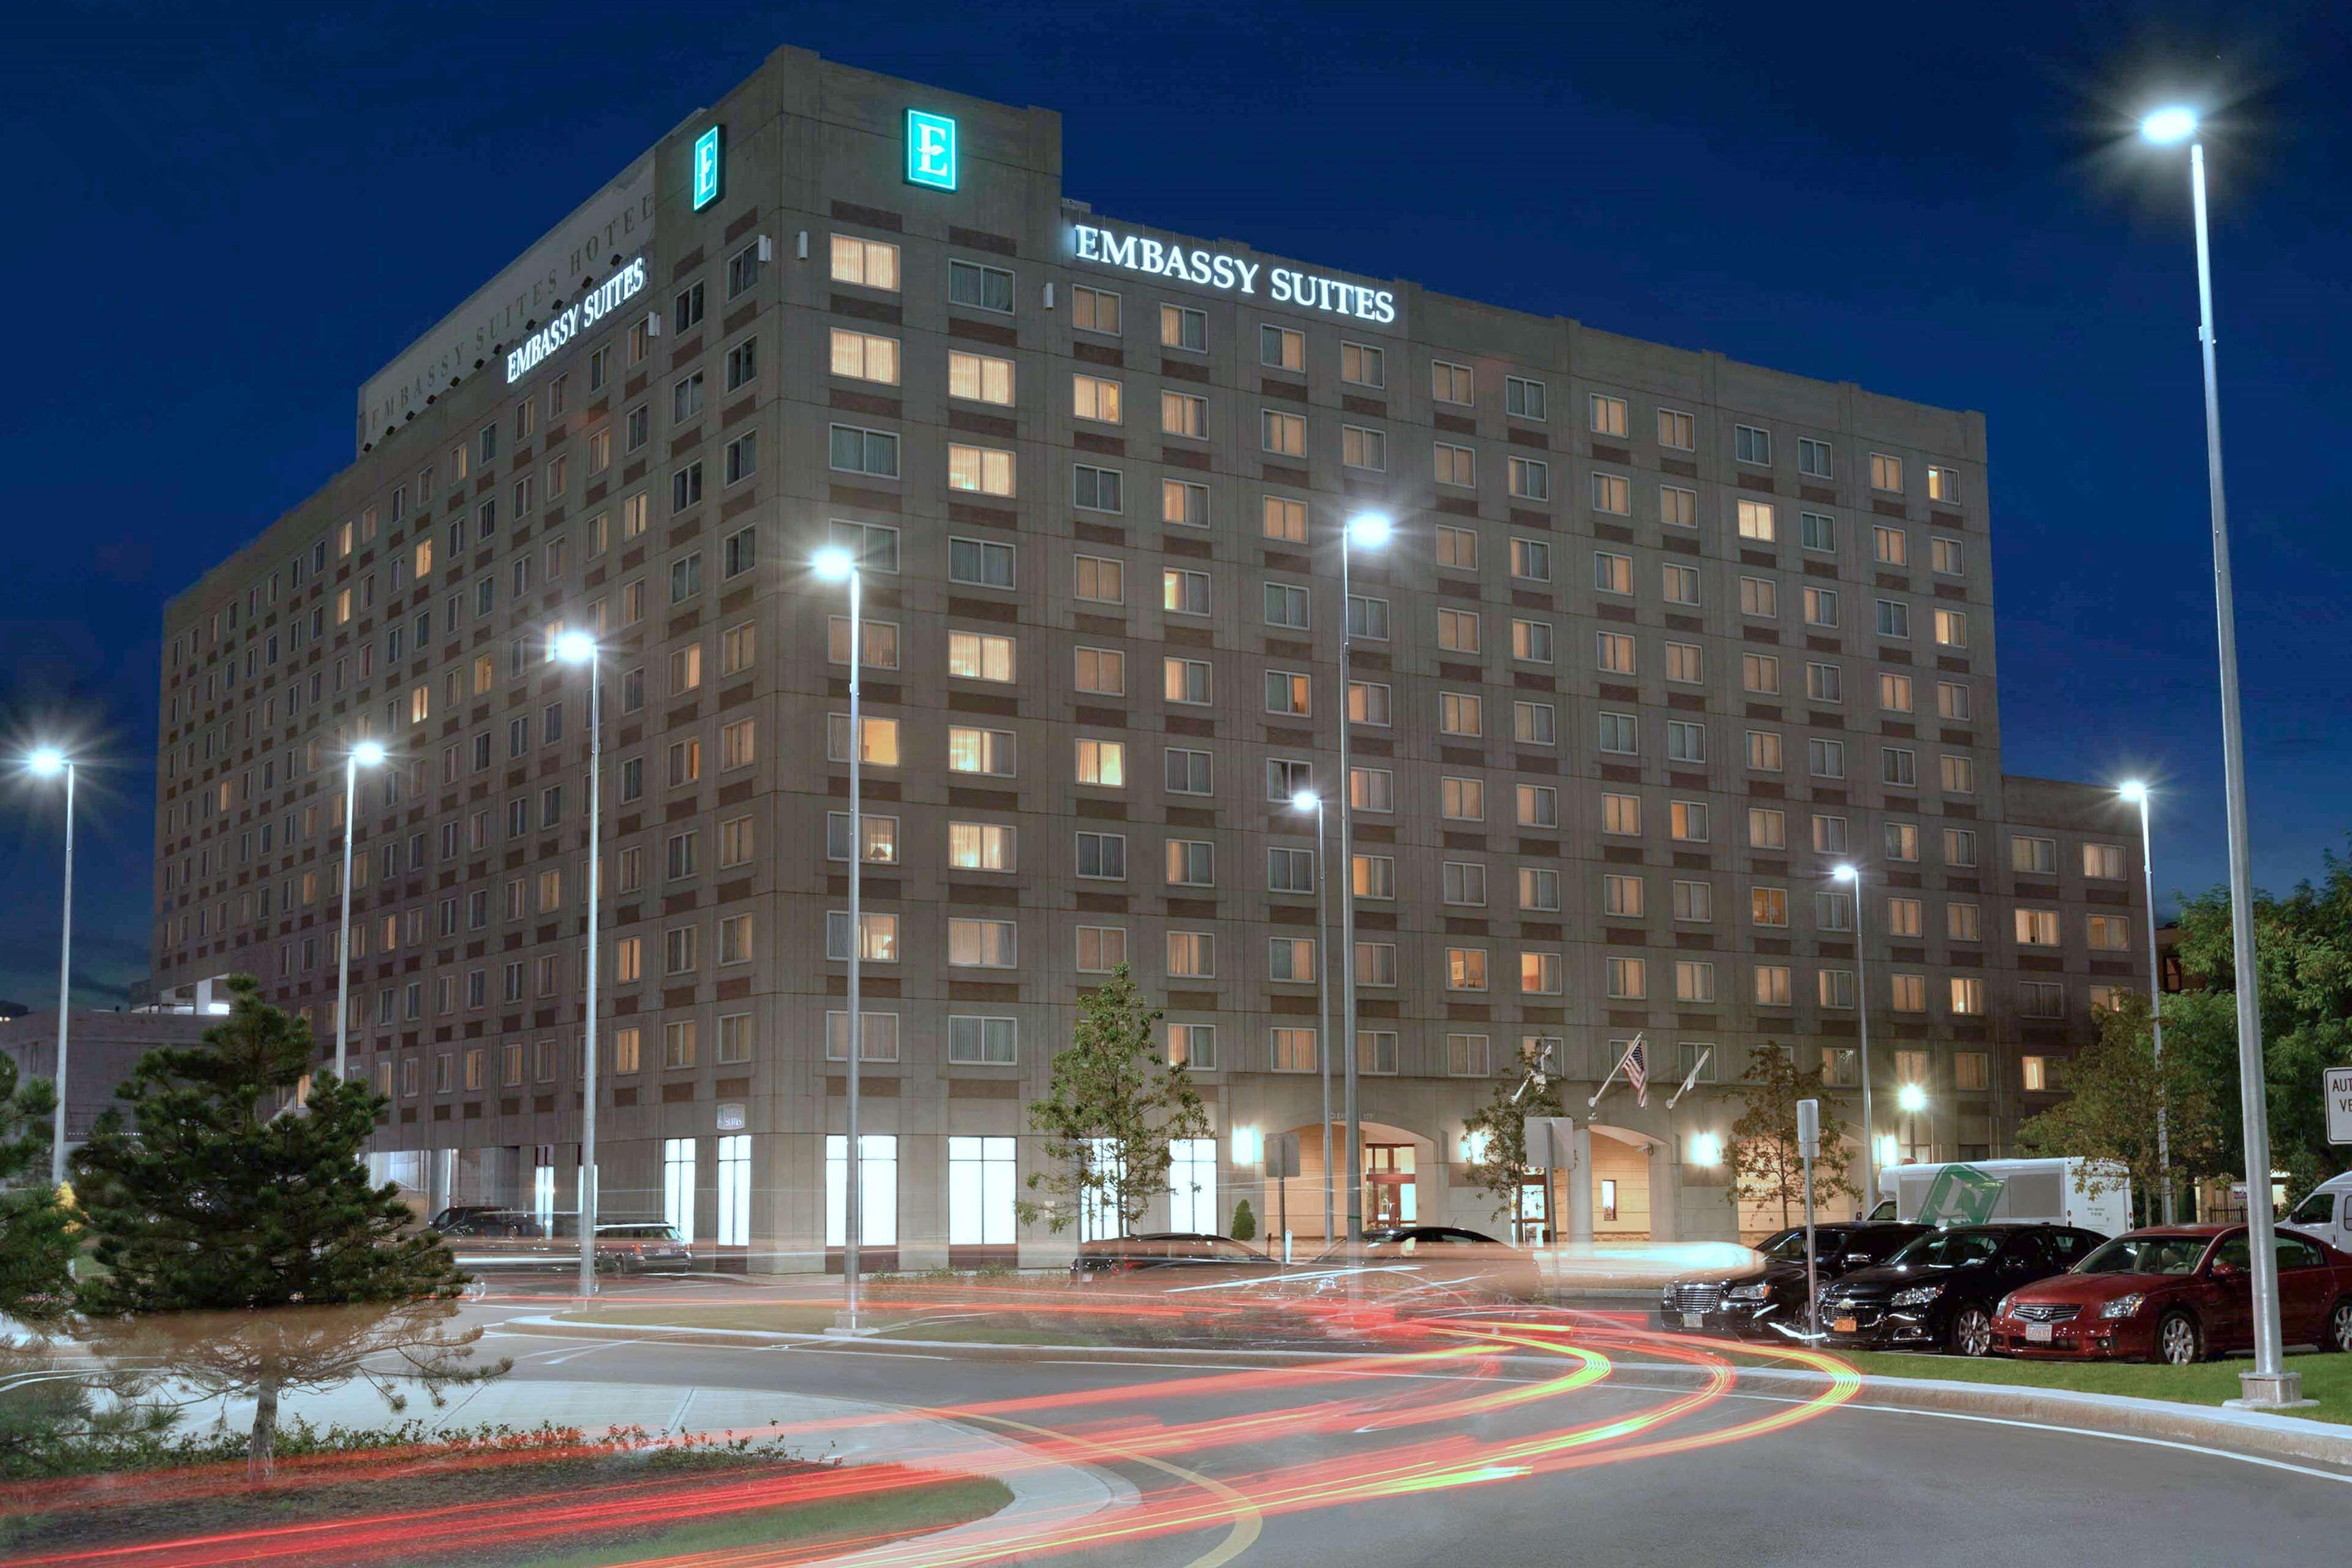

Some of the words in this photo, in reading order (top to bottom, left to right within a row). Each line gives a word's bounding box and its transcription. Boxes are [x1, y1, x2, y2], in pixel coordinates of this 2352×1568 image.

[699, 141, 714, 196] E
[916, 123, 947, 177] E
[1076, 224, 1259, 293] EMBASSY
[1271, 268, 1395, 323] SUITES
[507, 304, 579, 383] EMBASSY
[584, 257, 644, 328] SUITES
